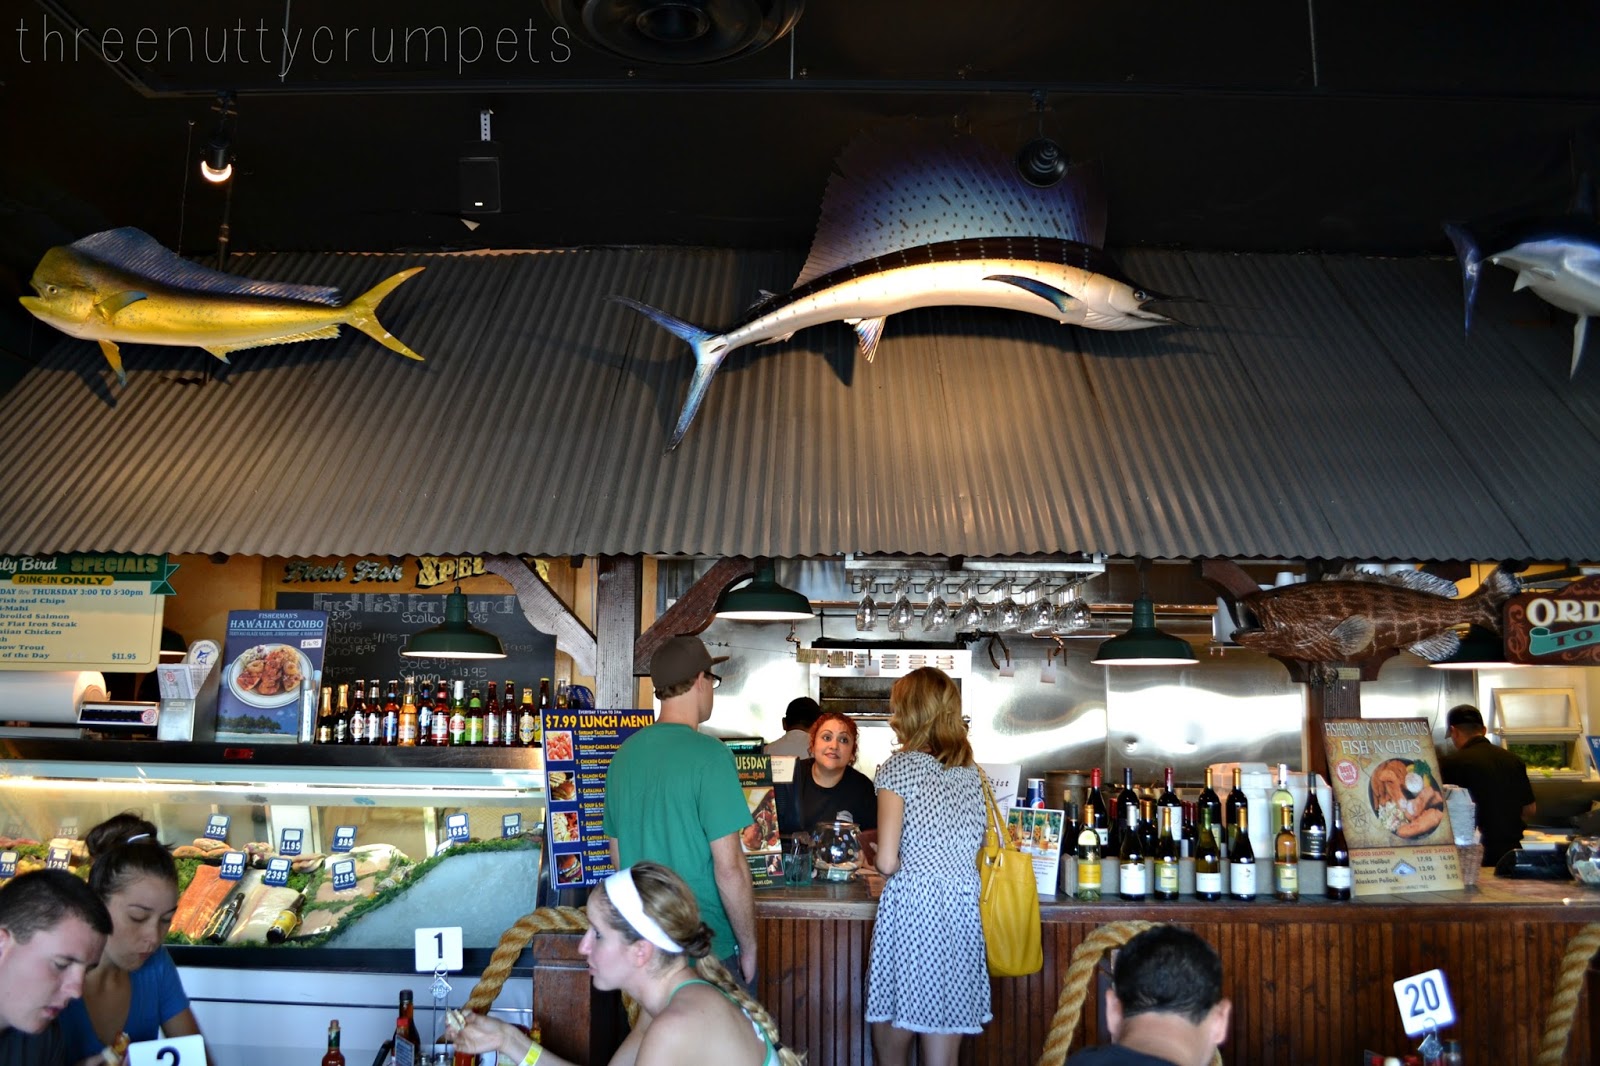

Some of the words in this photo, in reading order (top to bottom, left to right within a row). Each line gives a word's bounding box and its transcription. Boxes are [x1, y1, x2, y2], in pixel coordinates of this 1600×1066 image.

[20, 556, 58, 571] Bird
[71, 557, 158, 573] SPECIALS
[283, 560, 347, 583] Fresh
[350, 560, 403, 583] Fish
[19, 576, 58, 584] DINE-IN
[61, 577, 106, 585] ONLY
[40, 597, 65, 605] Chips
[313, 593, 364, 611] Fresh
[364, 594, 405, 613] Fish
[230, 620, 285, 629] HAWAIIAN
[287, 620, 324, 628] COMBO
[327, 633, 372, 645] Albacore
[1550, 630, 1593, 646] TO
[399, 658, 431, 669] Sole
[545, 715, 577, 728] $7.99
[579, 715, 618, 728] LUNCH
[620, 715, 653, 728] MENU
[1325, 722, 1372, 737] FISHERMAN'S
[1373, 722, 1398, 736] WORLD
[1399, 721, 1429, 736] FAMOUS
[1341, 740, 1370, 754] FISH
[1385, 739, 1422, 754] CHIPS
[735, 756, 767, 770] UESDAY
[206, 825, 227, 835] 1395
[447, 826, 469, 837] 1695
[506, 826, 520, 836] 495
[281, 841, 301, 851] 1195
[337, 838, 354, 847] 995
[2, 863, 16, 872] 795
[48, 861, 68, 870] 1295
[222, 864, 243, 874] 1395
[266, 870, 287, 881] 2395
[333, 873, 355, 884] 2195
[434, 932, 443, 959] 1
[1404, 977, 1440, 1018] 20
[156, 1045, 181, 1066] 2
